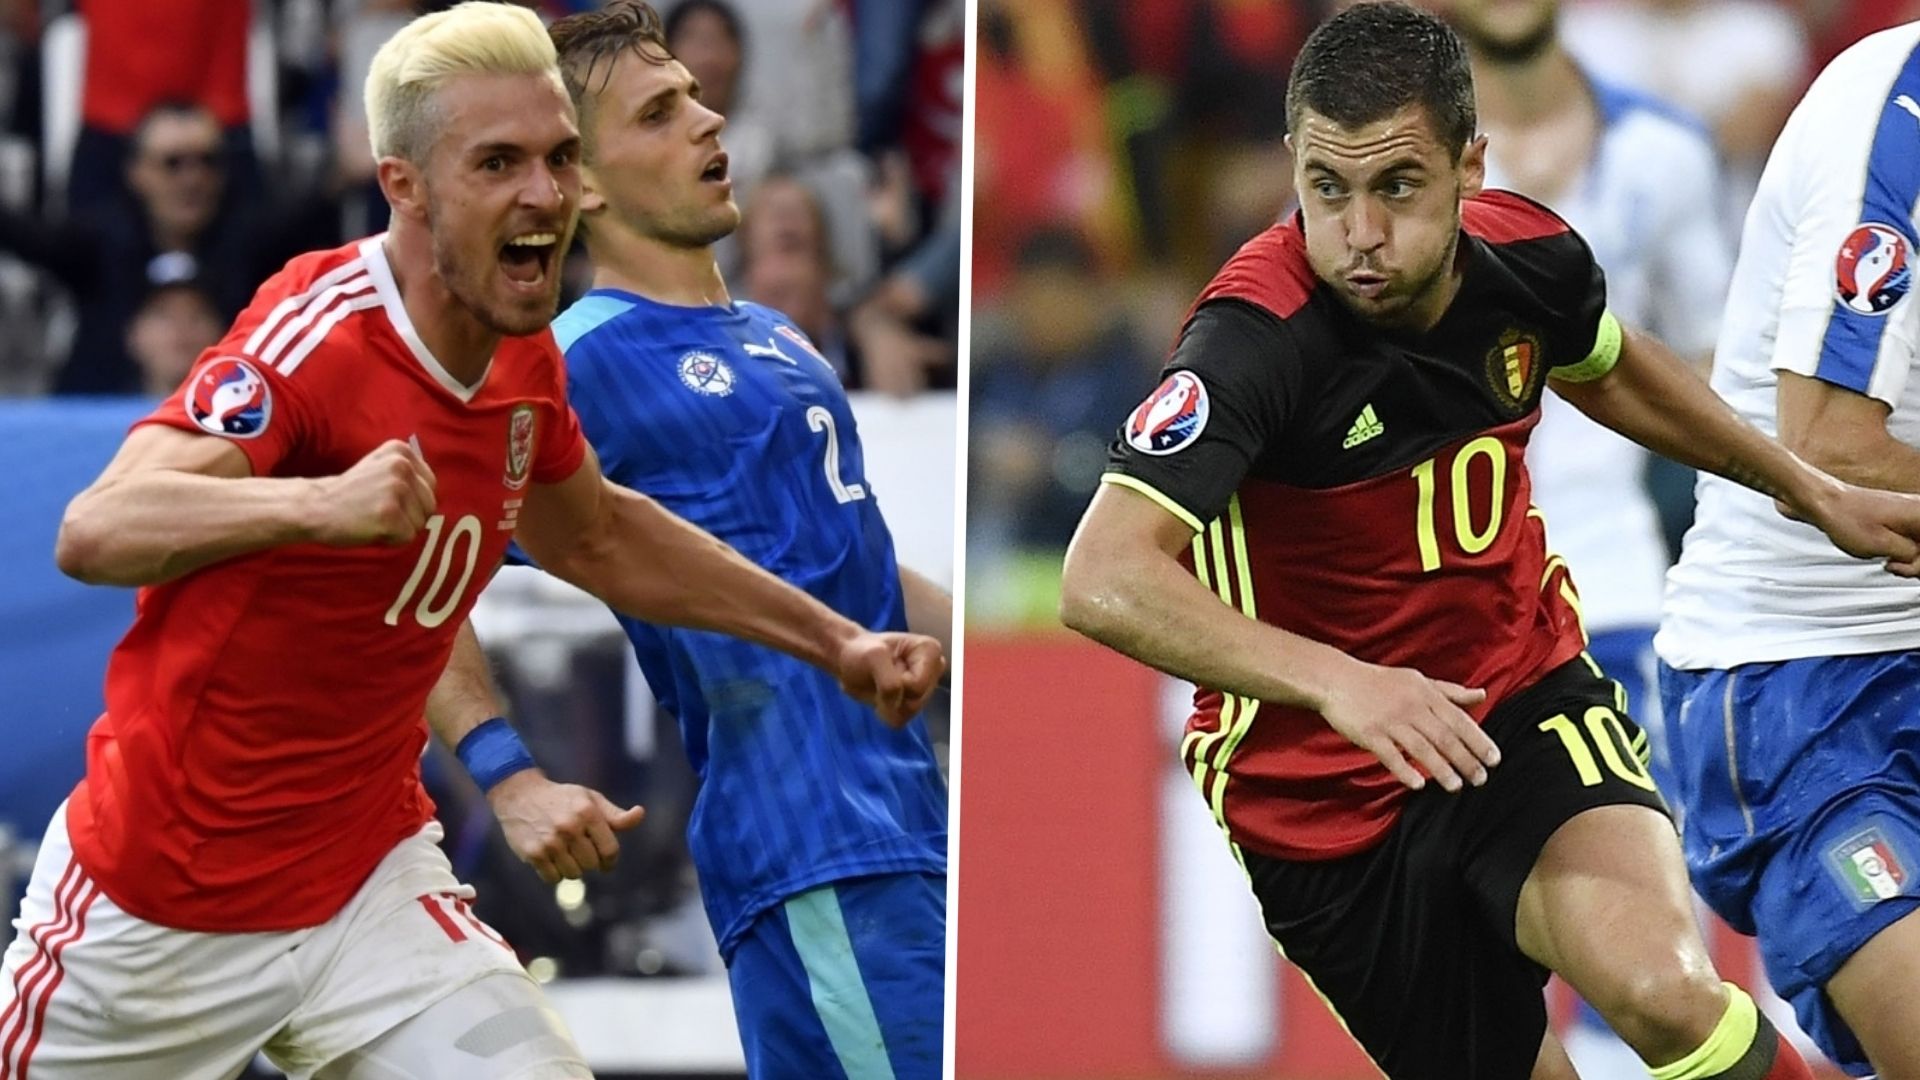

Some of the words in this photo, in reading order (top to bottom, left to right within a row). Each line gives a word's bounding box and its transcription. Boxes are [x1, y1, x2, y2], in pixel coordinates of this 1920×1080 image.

[806, 405, 866, 504] 2
[1342, 421, 1384, 450] adidas
[1411, 436, 1507, 573] 10
[384, 514, 482, 628] 10
[1537, 705, 1656, 793] 10
